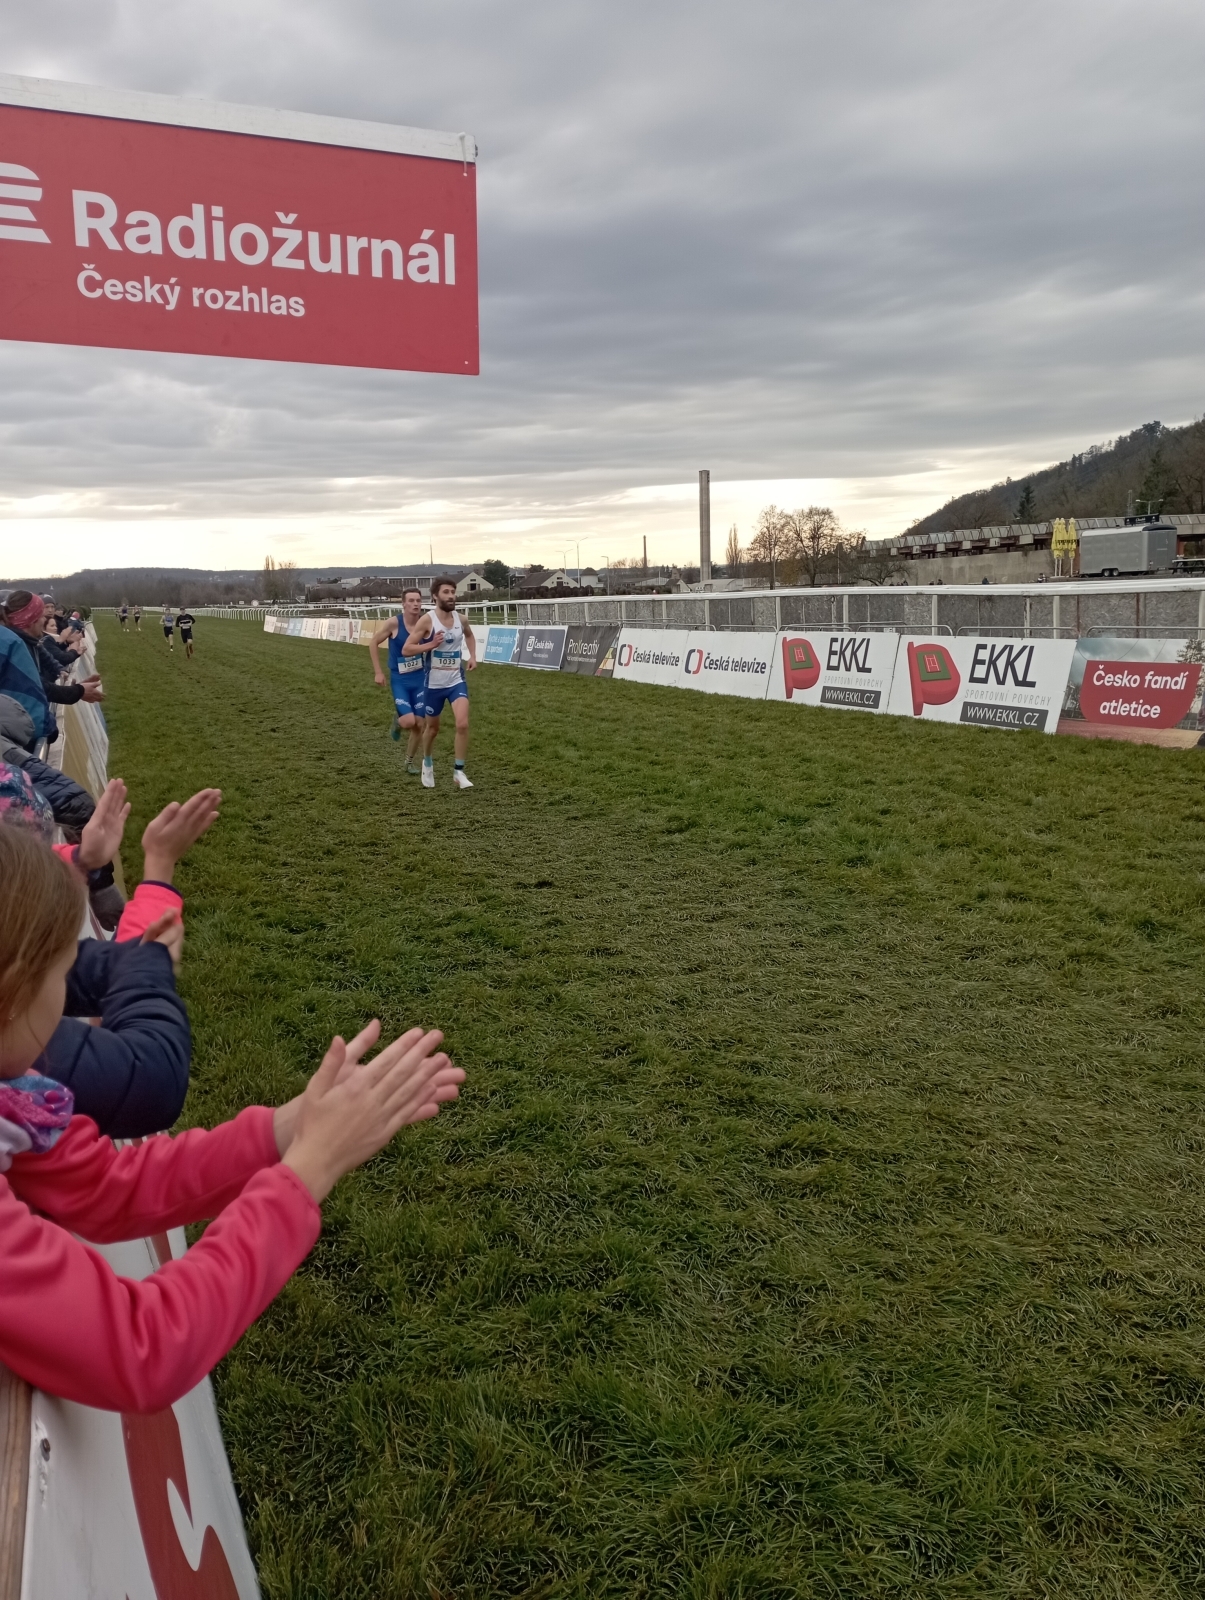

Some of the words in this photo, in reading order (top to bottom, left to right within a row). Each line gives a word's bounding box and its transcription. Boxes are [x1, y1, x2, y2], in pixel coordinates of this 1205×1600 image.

[72, 189, 456, 285] Radiožurnál
[76, 263, 180, 311] Český
[192, 286, 306, 317] rozhlas
[632, 646, 651, 664] Česká
[651, 648, 680, 667] televize
[703, 652, 730, 672] Česká
[731, 656, 767, 674] televize
[826, 637, 873, 674] EKKL
[968, 643, 1037, 688] EKKL
[823, 675, 854, 687] SPORTOVNÍ
[855, 678, 884, 688] POVRCHY
[1093, 664, 1141, 688] Česko
[1144, 670, 1190, 691] fandí
[825, 689, 876, 706] WWW.EKKL.CZ
[964, 689, 1010, 702] SPORTOVNÍ
[1012, 693, 1053, 707] POVRCHY
[966, 706, 1040, 727] WWW.EKKL.CZ
[1099, 698, 1162, 719] atletice
